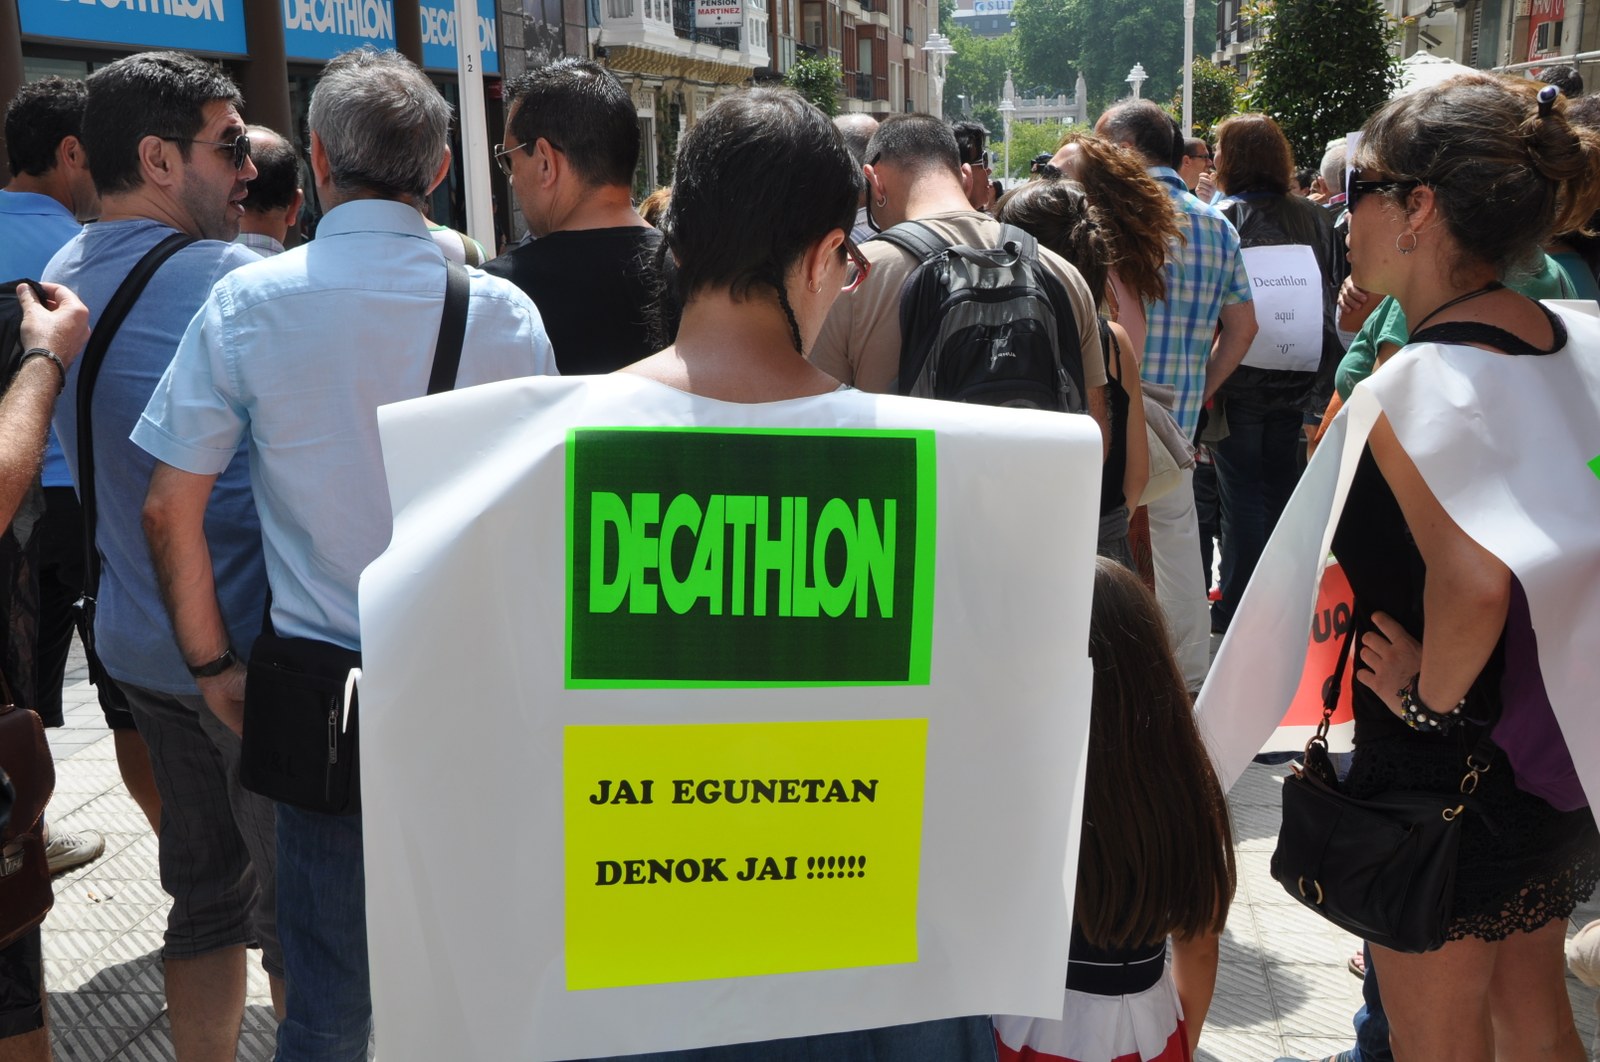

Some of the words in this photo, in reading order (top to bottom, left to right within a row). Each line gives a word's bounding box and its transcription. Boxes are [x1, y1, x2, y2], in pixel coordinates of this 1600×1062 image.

[284, 0, 393, 40] DECATHLON
[420, 6, 497, 52] DECAON
[1253, 275, 1307, 287] Decathlon
[1274, 309, 1295, 323] aqui
[589, 491, 897, 618] DECATHLON
[589, 780, 654, 805] JAI
[672, 779, 879, 804] EGUNETAN
[595, 858, 728, 886] DENOK
[736, 856, 798, 881] JAI
